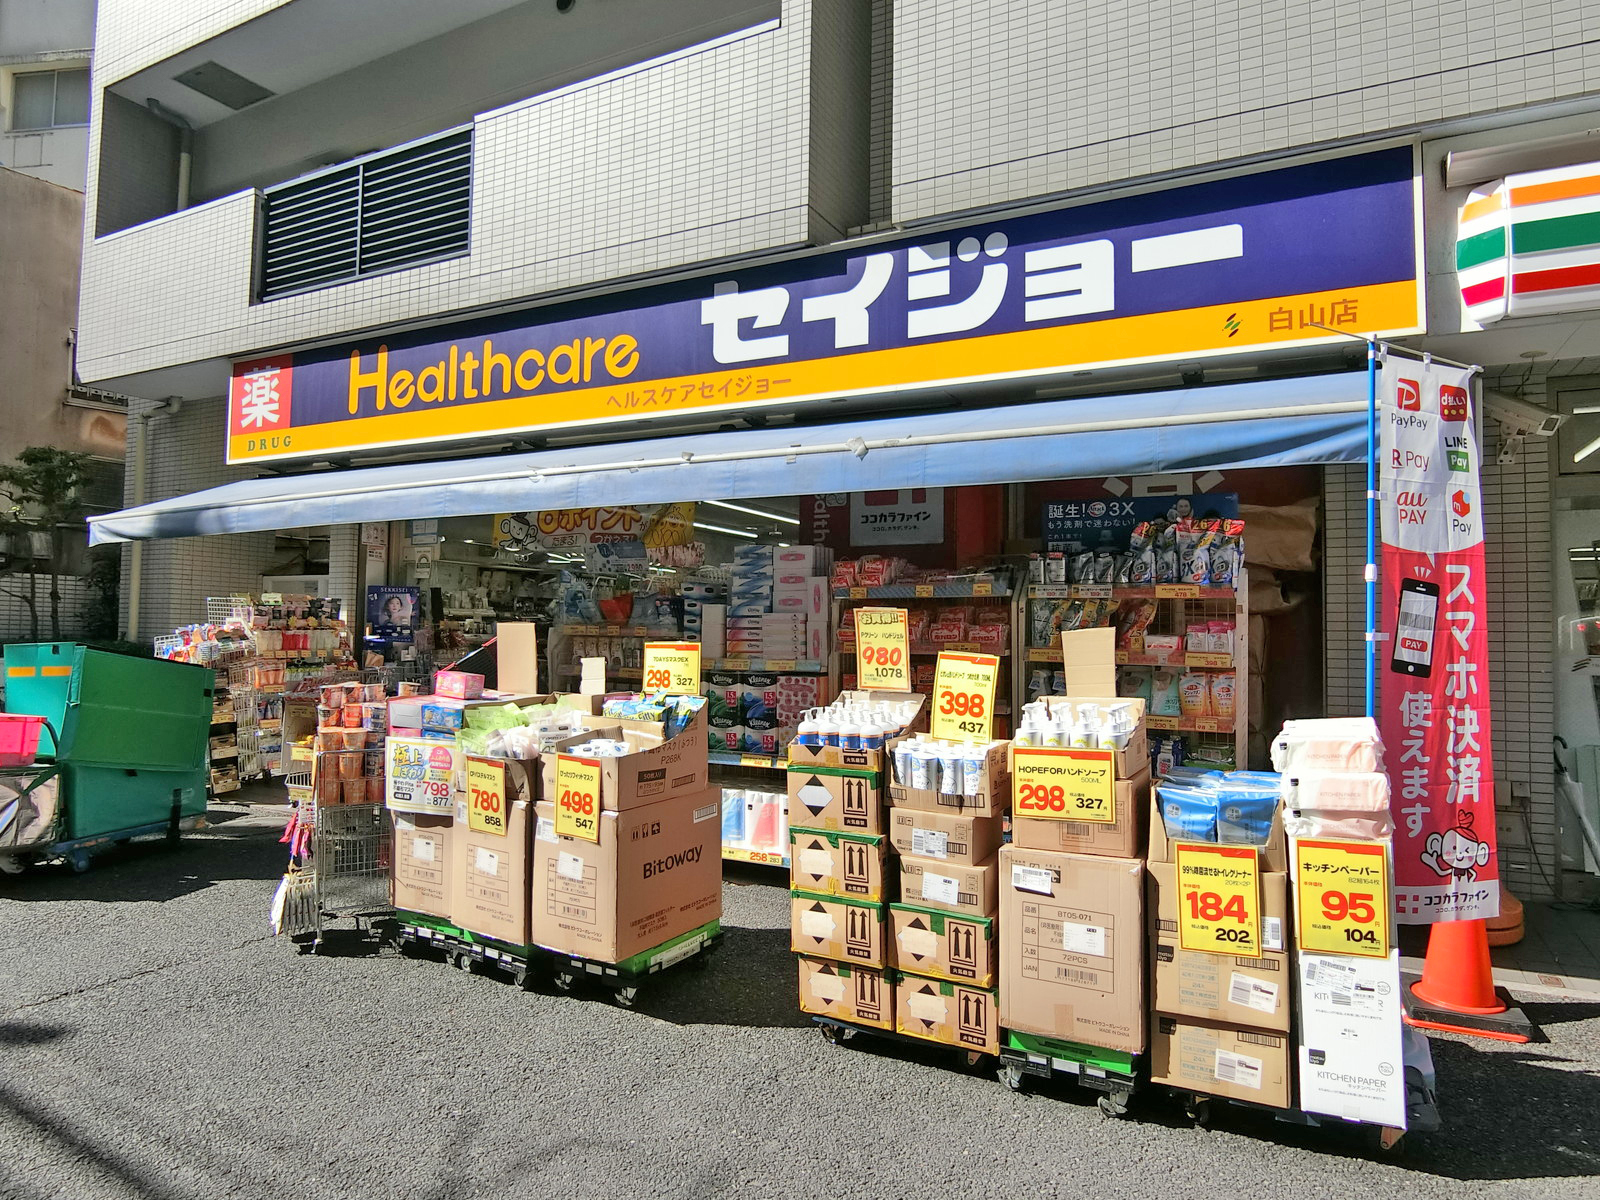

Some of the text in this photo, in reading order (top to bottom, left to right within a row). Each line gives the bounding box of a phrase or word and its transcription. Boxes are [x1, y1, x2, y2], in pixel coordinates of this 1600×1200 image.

[701, 223, 1243, 364] セイジョー
[1269, 299, 1359, 332] 白山店
[348, 334, 640, 414] Healthcare
[241, 367, 281, 428] 薬
[606, 378, 792, 410] ヘルスケアセイジョー
[1441, 393, 1466, 406] d払い
[1391, 413, 1428, 430] PayPay
[247, 435, 293, 452] DRUG
[1445, 437, 1468, 449] LINE
[1406, 451, 1430, 472] Pay
[1450, 454, 1468, 469] Pay
[1397, 491, 1428, 507] au
[861, 511, 931, 524] ココカラファイン
[1048, 503, 1086, 518] 誕生!
[1108, 501, 1136, 517] 3X
[1399, 509, 1427, 525] PAY
[1453, 518, 1472, 536] Pay
[1405, 640, 1423, 650] PAY
[862, 646, 902, 666] 980
[646, 669, 671, 689] 298
[875, 667, 903, 679] 1,078
[676, 677, 693, 686] 327
[1445, 564, 1482, 804] スマホ決済
[939, 690, 985, 718] 398
[958, 721, 984, 734] 437
[393, 744, 423, 766] 極上
[660, 754, 682, 765] P268K
[1018, 766, 1107, 776] HOPEFORハンドソープ
[1399, 691, 1431, 838] 使えます
[423, 781, 450, 797] 798
[433, 797, 449, 807] 877
[471, 788, 500, 813] 780
[560, 790, 594, 815] 498
[1019, 784, 1065, 811] 298
[1076, 798, 1104, 809] 327
[484, 815, 501, 827] 858
[575, 818, 594, 830] 547
[643, 844, 703, 879] Bitoway
[750, 850, 768, 862] 258
[1182, 865, 1252, 878] 99%除菌流せるトイレクリーナー
[1424, 890, 1490, 906] ココカラファイン
[1186, 891, 1248, 924] 184
[1321, 890, 1375, 924] 95
[1215, 928, 1250, 943] 202
[1344, 928, 1377, 943] 104
[1023, 963, 1038, 972] JAN
[1062, 954, 1088, 965] 72PCS
[1316, 1070, 1387, 1089] KITCHEN PAPER
